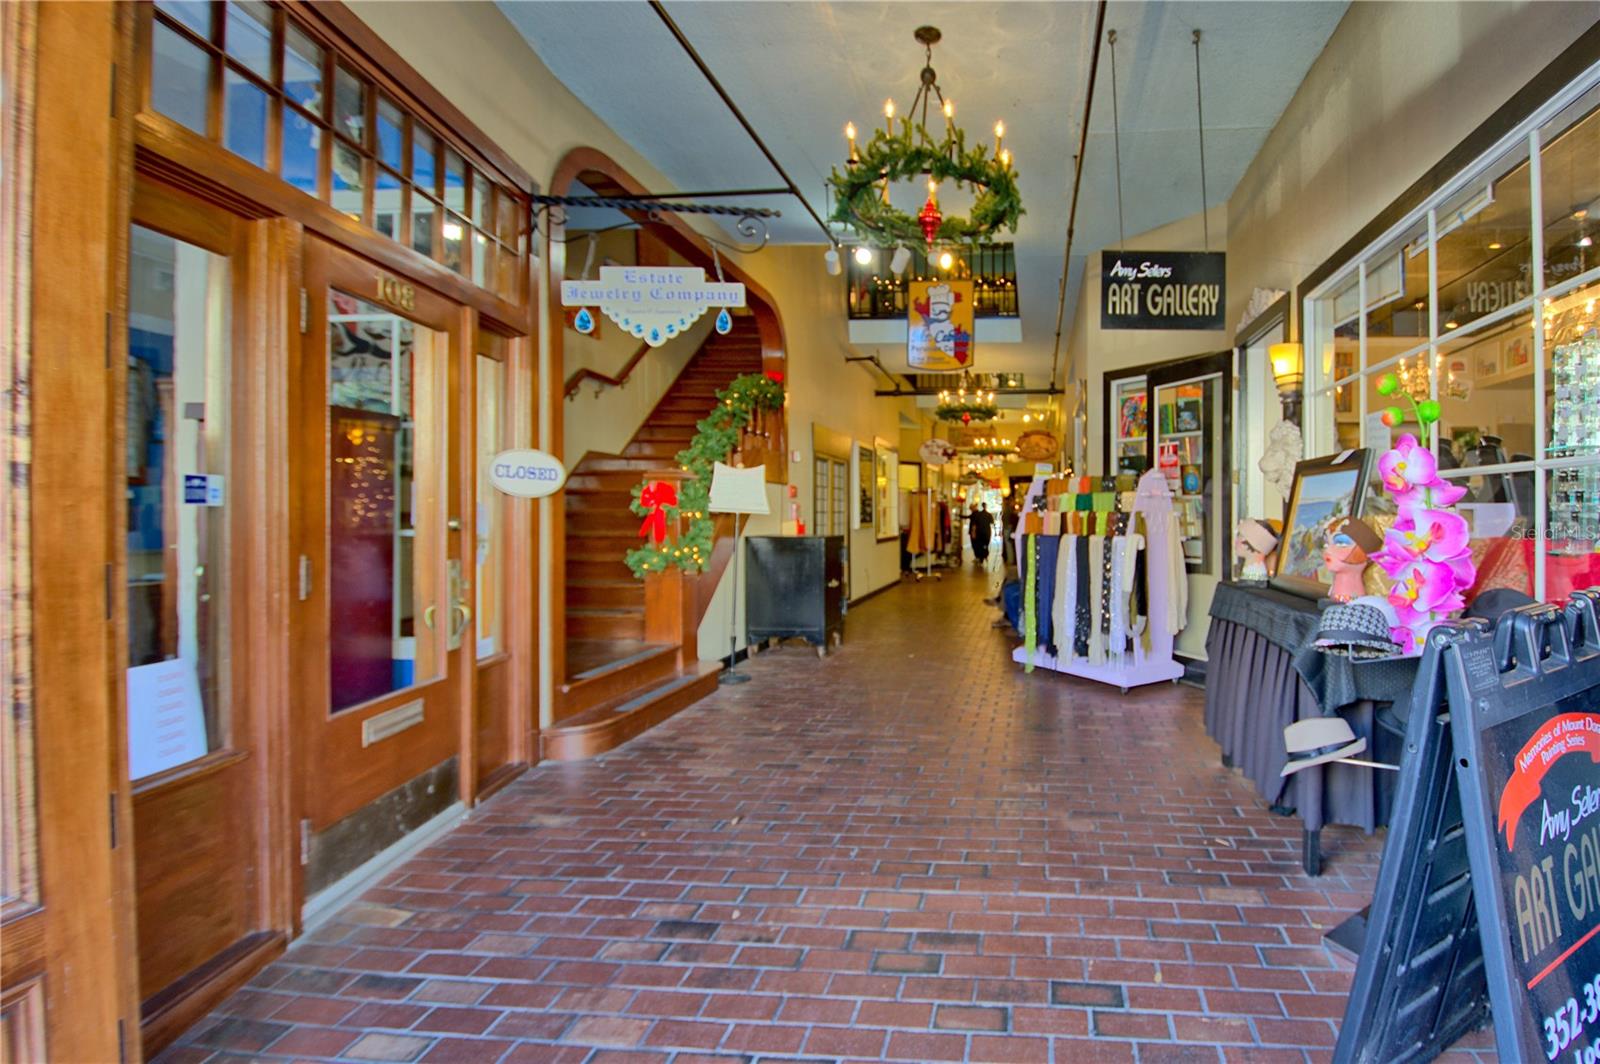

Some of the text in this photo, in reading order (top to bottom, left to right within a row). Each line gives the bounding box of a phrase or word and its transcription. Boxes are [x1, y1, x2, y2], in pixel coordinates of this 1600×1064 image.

[624, 270, 685, 284] Estate
[1110, 259, 1137, 280] Amy
[373, 270, 416, 312] 108
[567, 286, 739, 303] Jewelry Company
[1107, 283, 1219, 316] ART GALLERY
[495, 464, 559, 481] CLOSED
[1519, 731, 1553, 774] Memories
[1553, 722, 1562, 737] of
[1562, 719, 1585, 732] Mount
[1541, 734, 1585, 766] Painting Series
[1540, 799, 1570, 846] Amy
[1515, 826, 1600, 963] ART GAL
